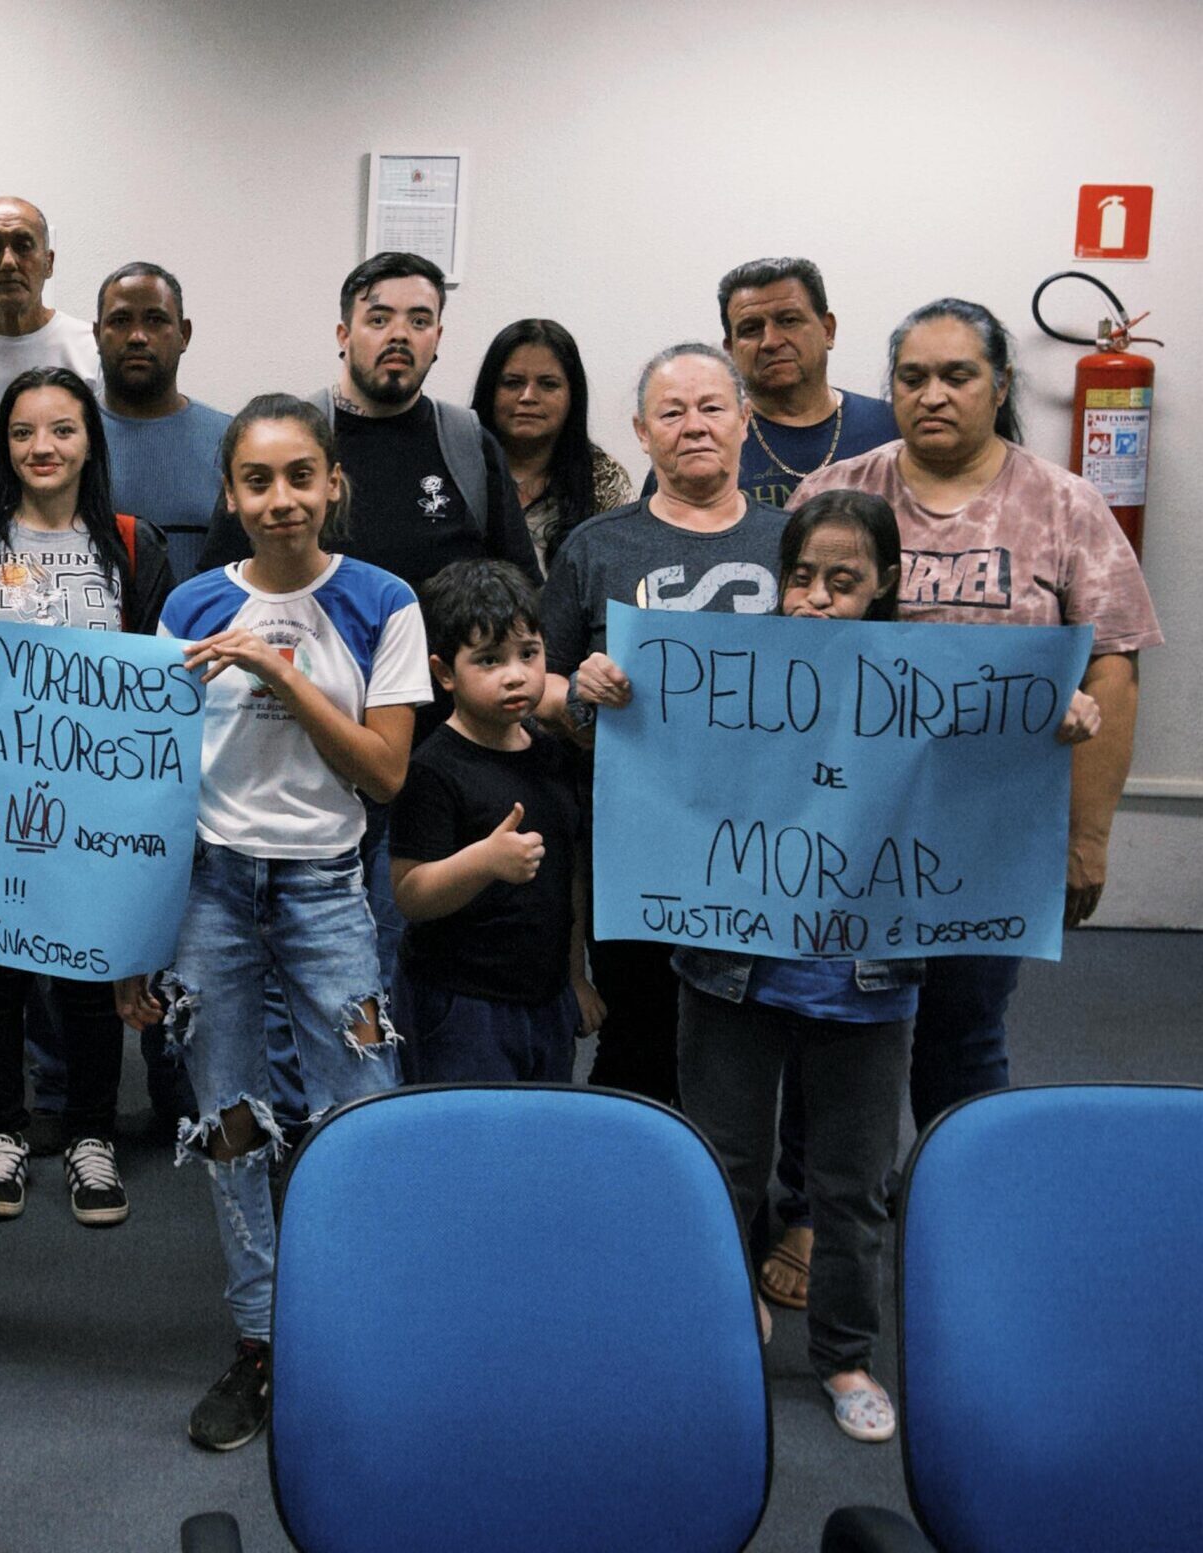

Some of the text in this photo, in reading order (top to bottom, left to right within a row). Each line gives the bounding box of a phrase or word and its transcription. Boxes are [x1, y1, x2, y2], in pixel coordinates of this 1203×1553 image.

[638, 637, 822, 733] PELO
[812, 762, 847, 788] DE
[5, 781, 66, 845] NÃO
[706, 818, 963, 899] MORAR
[640, 892, 773, 944] JUSTIÇA
[793, 909, 868, 954] NÃO
